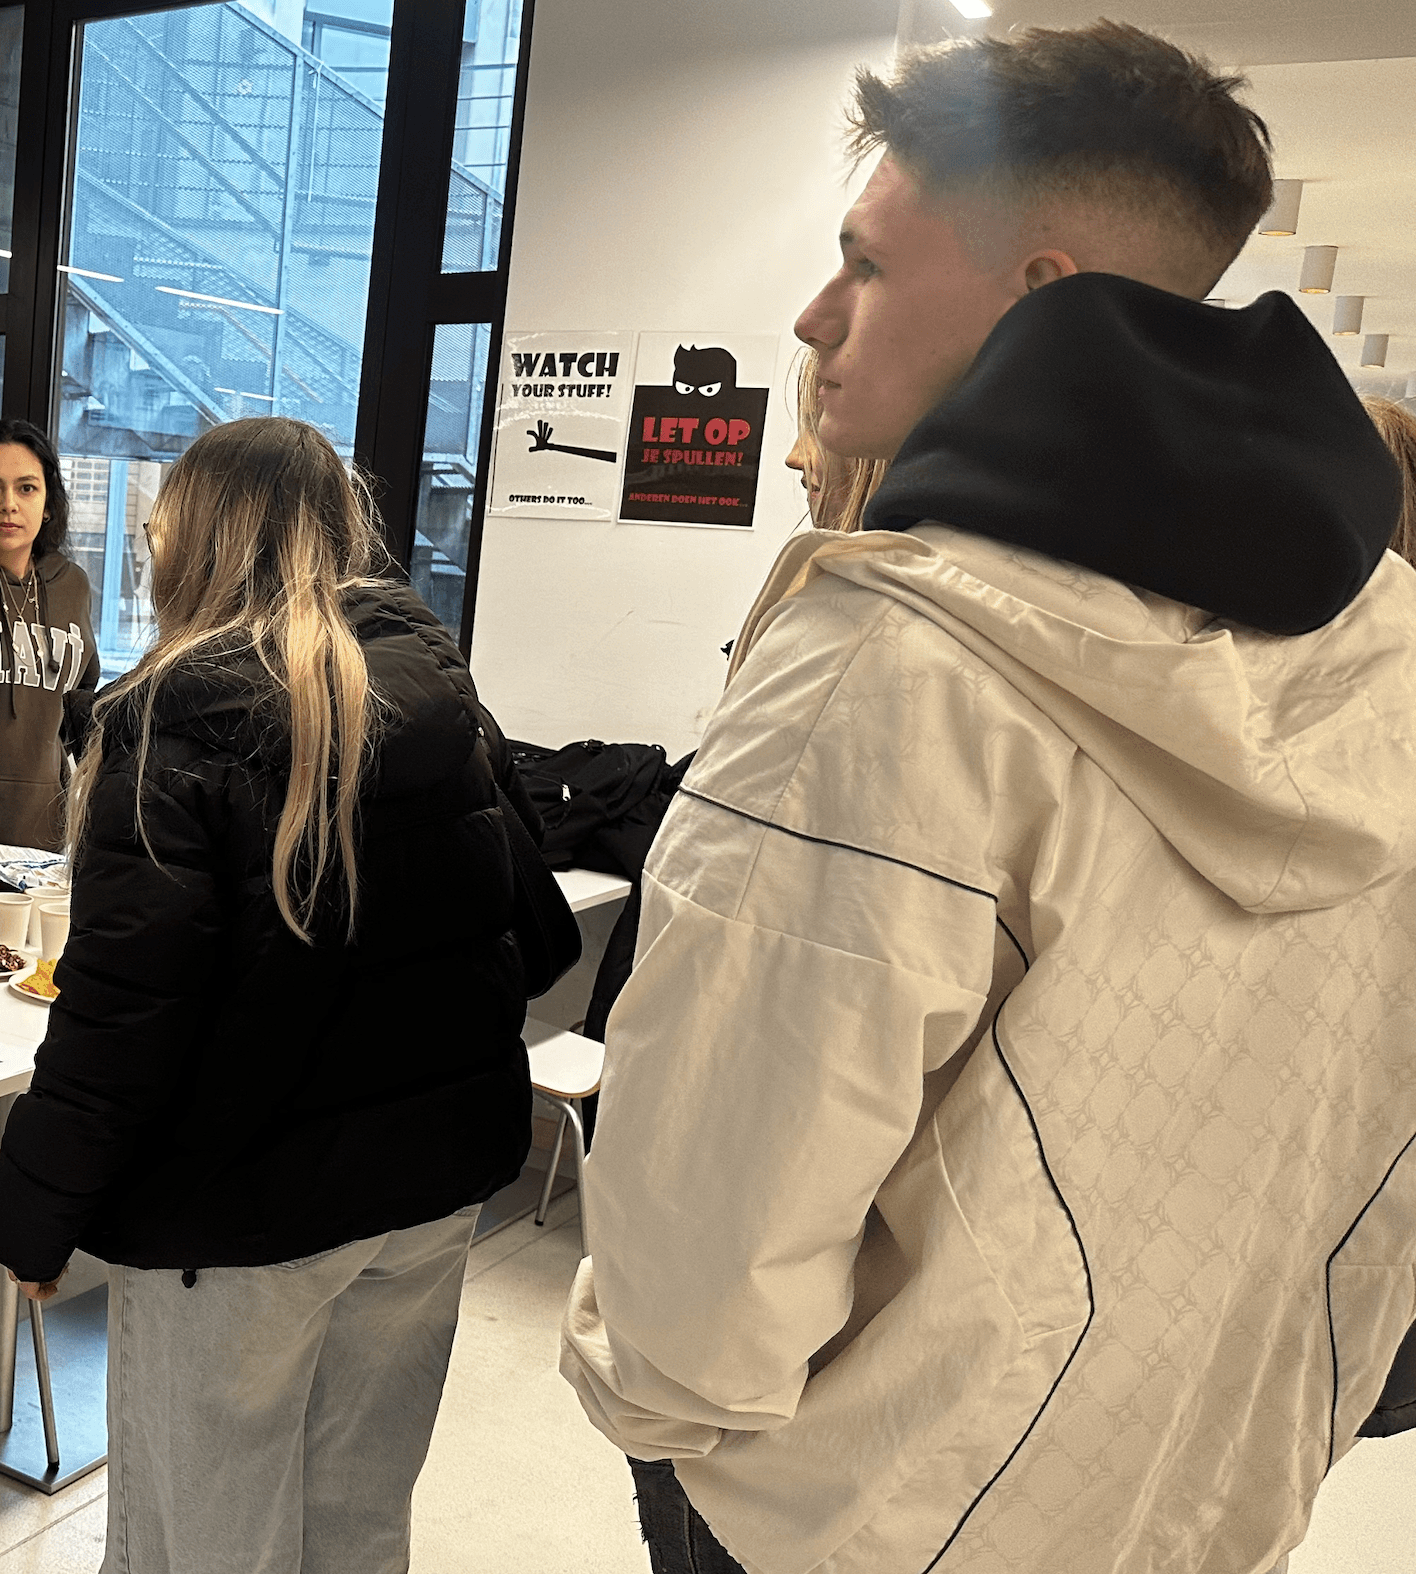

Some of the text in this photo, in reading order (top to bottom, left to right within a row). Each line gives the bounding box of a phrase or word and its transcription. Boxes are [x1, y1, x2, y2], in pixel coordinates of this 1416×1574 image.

[511, 352, 620, 378] WATCH
[511, 383, 612, 398] YOUR STUFF!
[642, 416, 751, 446] LET OP
[641, 449, 744, 467] JE SPULLEN!
[509, 494, 542, 503] OTHERS
[543, 495, 555, 504] DO
[556, 496, 566, 504] IT
[629, 493, 671, 503] ANDEREN
[671, 495, 697, 504] DOEN
[698, 496, 718, 505] HET
